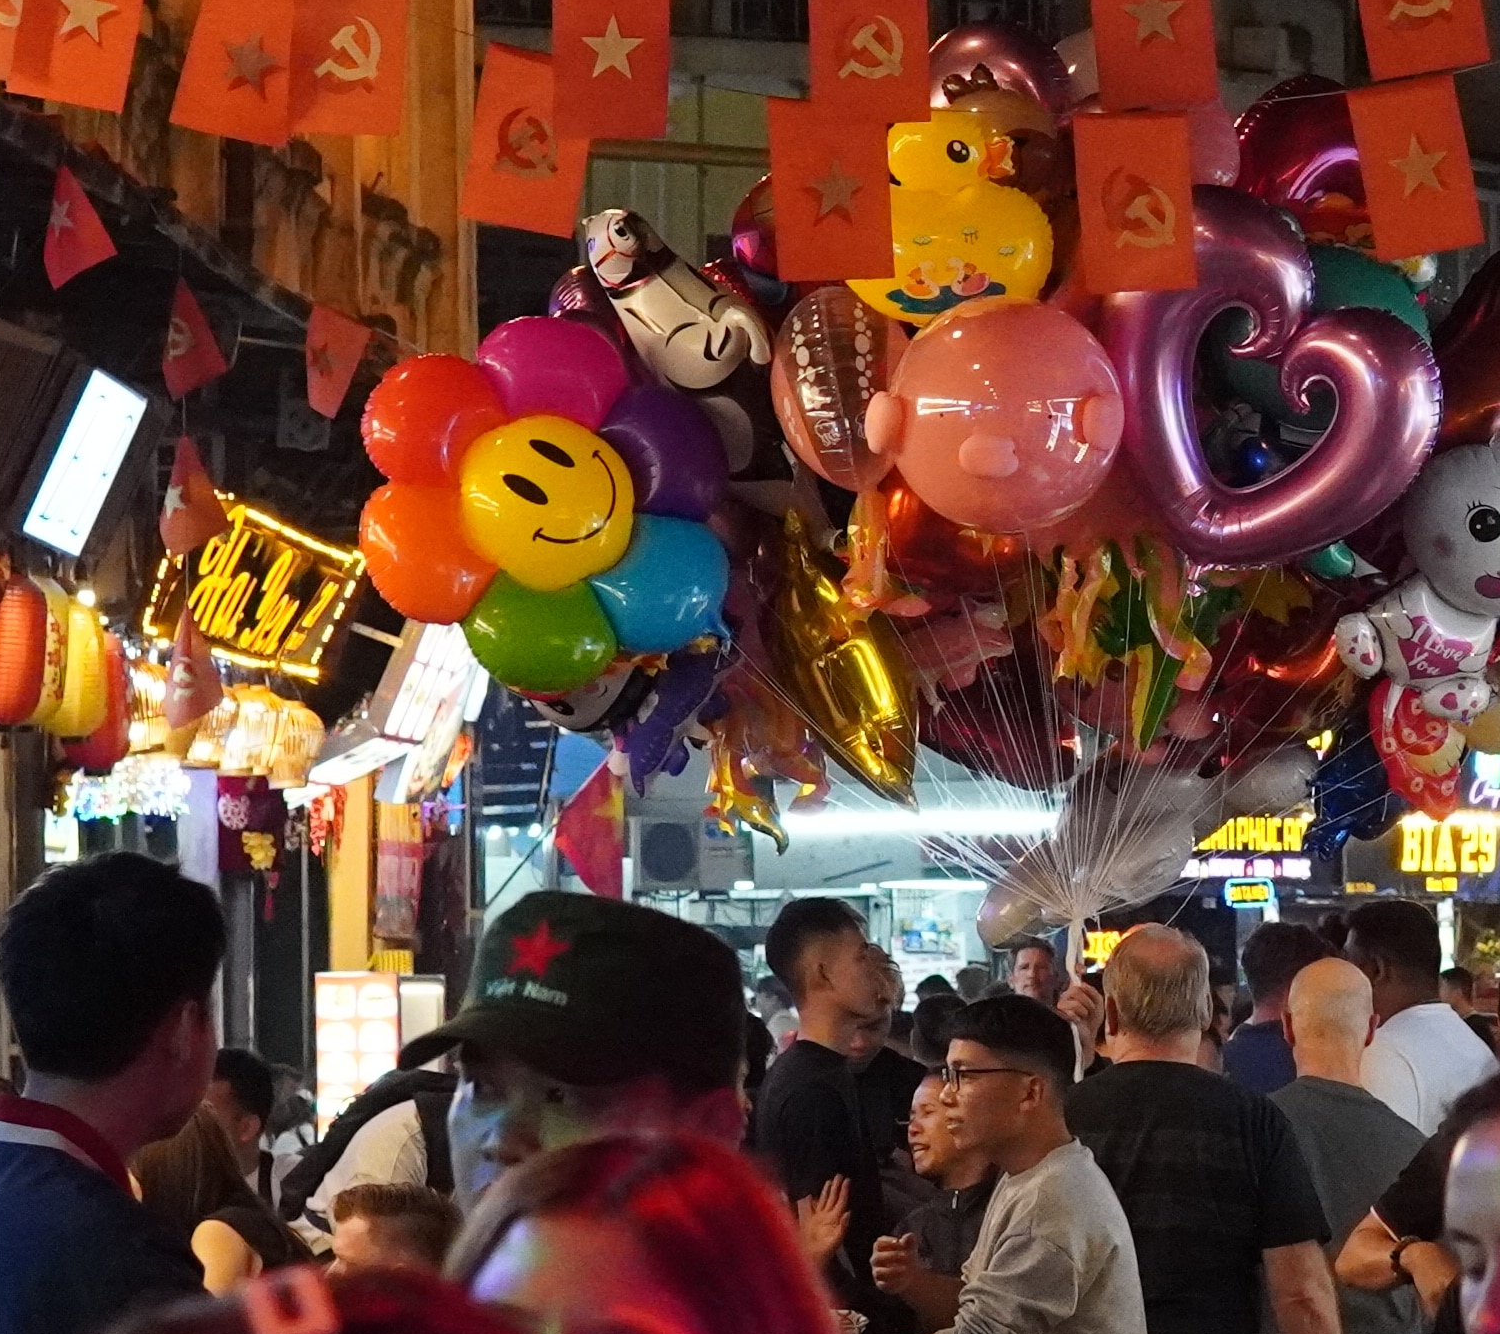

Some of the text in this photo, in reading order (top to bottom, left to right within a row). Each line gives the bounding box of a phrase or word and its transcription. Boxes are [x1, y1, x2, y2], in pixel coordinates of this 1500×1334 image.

[1408, 647, 1442, 677] You
[1411, 620, 1467, 662] I Love
[1400, 819, 1498, 874] BIA 29
